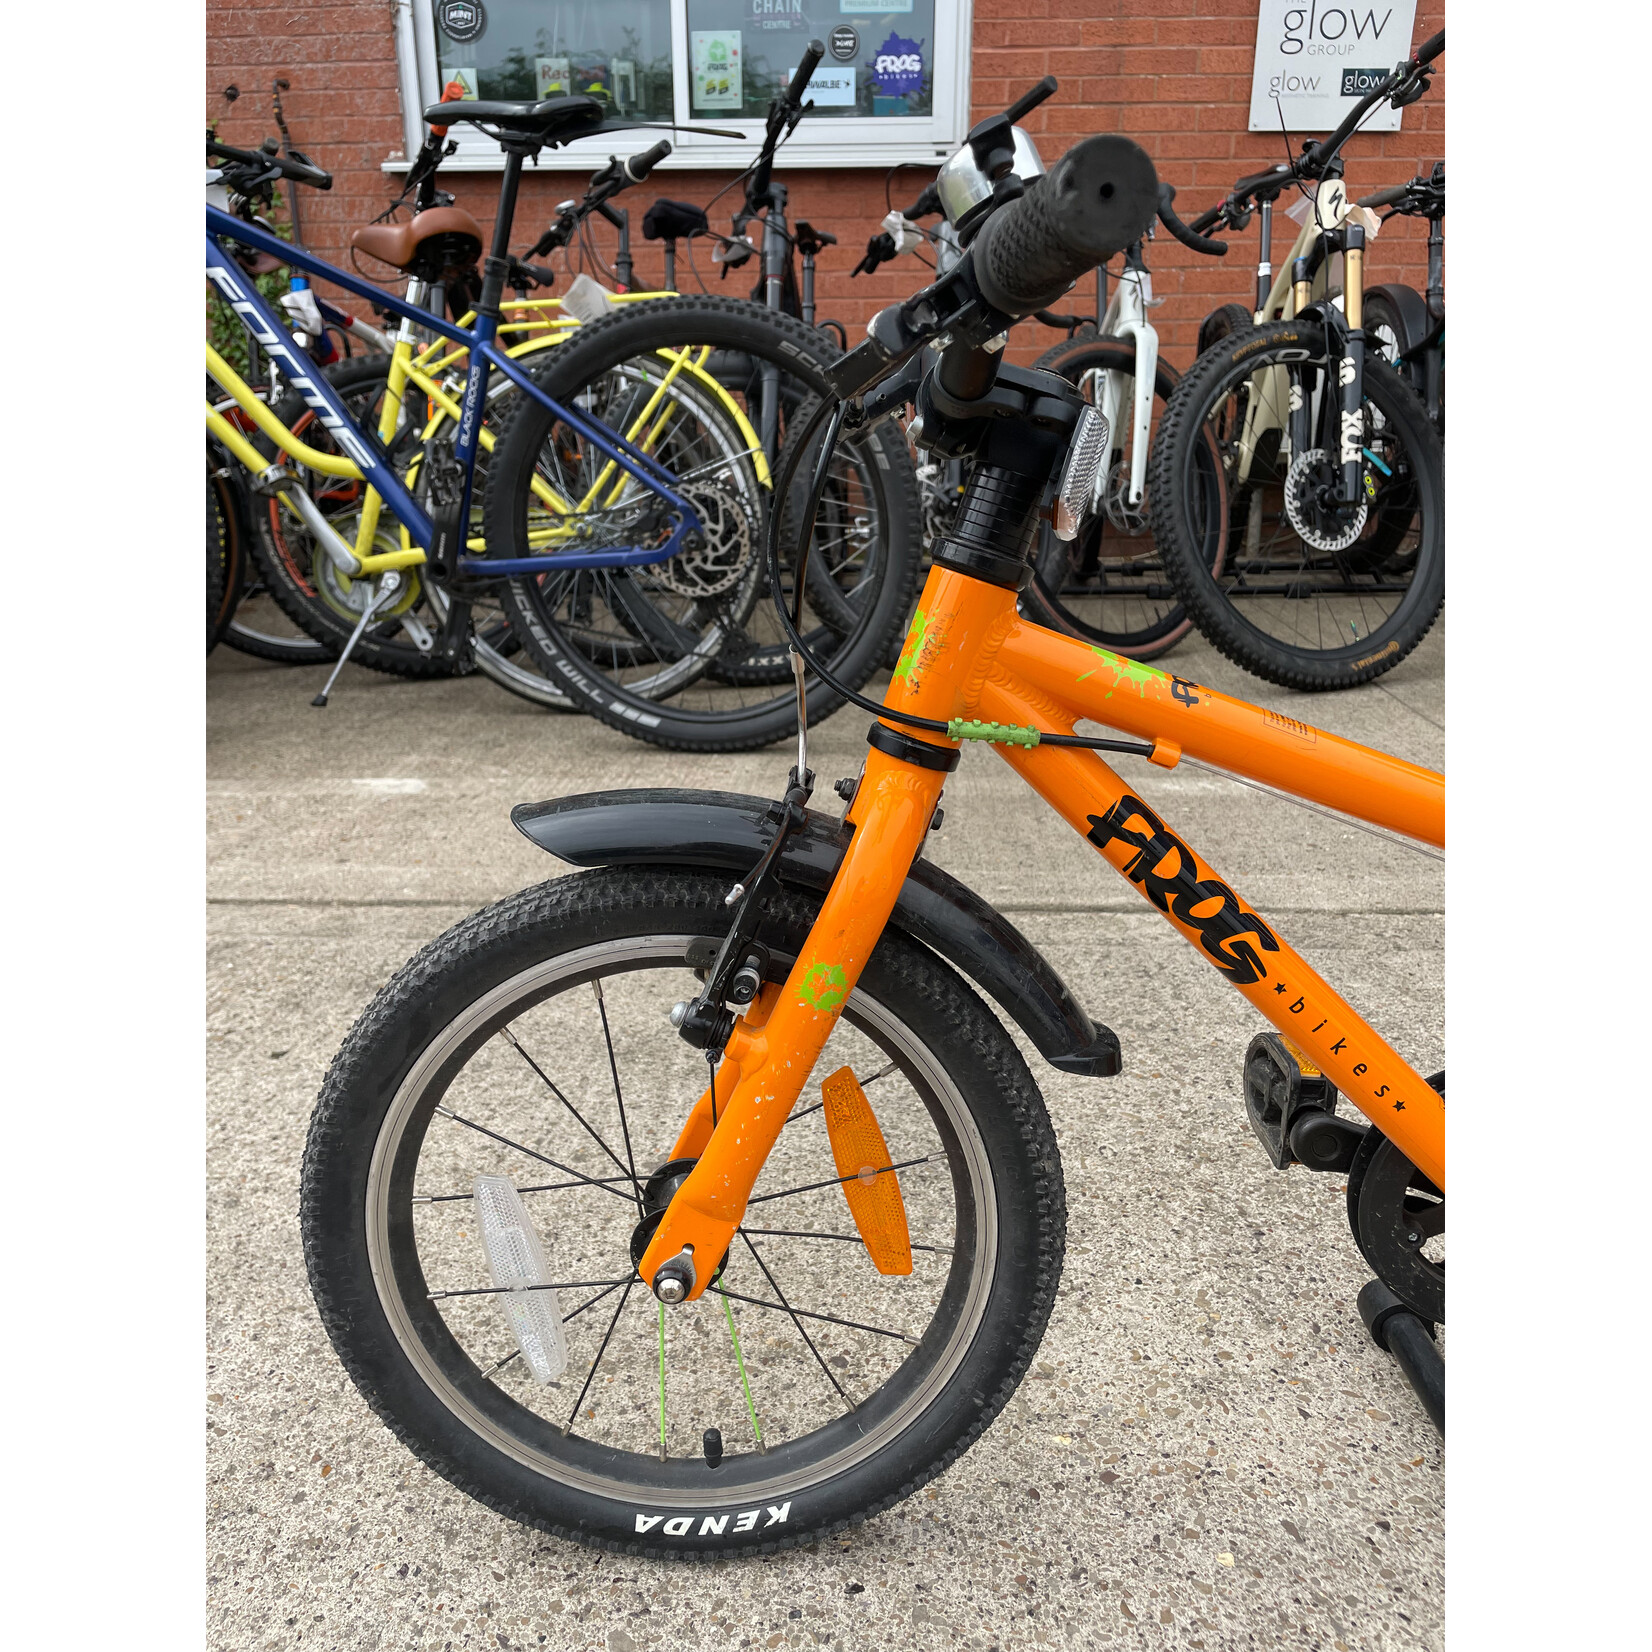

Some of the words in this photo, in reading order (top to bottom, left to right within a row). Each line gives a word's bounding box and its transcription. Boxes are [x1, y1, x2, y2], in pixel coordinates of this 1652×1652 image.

[753, 0, 801, 14] CHAIN
[1280, 0, 1393, 55] glow
[875, 54, 921, 73] FROG
[1307, 44, 1355, 56] GROUP
[1268, 69, 1321, 98] glow
[1344, 70, 1386, 94] glow
[555, 659, 604, 703] WILL
[1086, 794, 1280, 985] FROG
[1288, 996, 1391, 1098] bikes
[634, 1501, 792, 1536] KENDA
